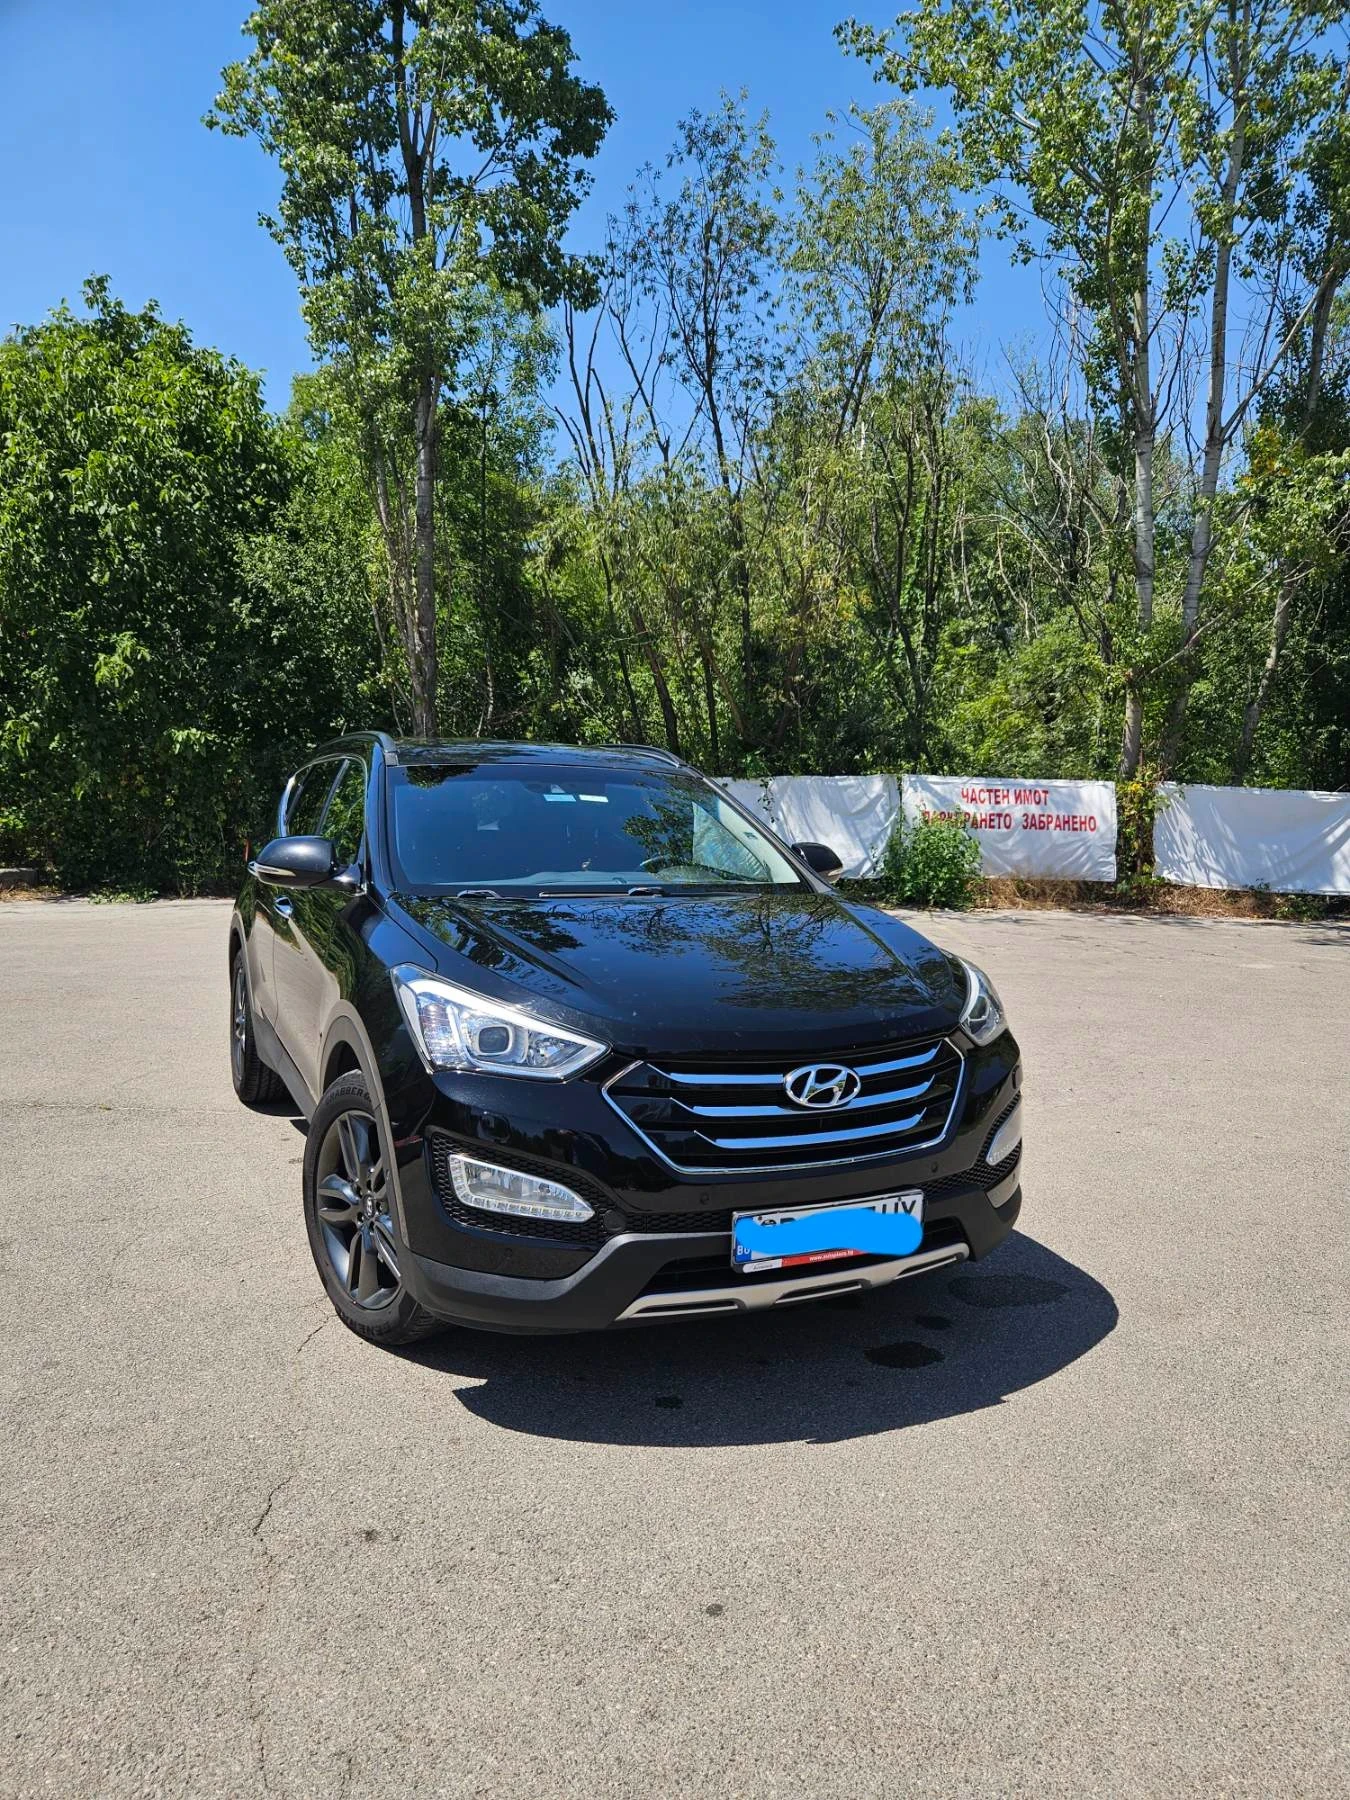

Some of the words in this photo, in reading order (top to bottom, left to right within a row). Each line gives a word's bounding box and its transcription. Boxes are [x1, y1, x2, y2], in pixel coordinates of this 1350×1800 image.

[961, 788, 1010, 806] ЧАСТЕН
[1014, 788, 1049, 806] ИМОТ
[922, 810, 1012, 830] ПРКРАНЕТО
[1022, 812, 1097, 833] ЗАБРАНЕНО
